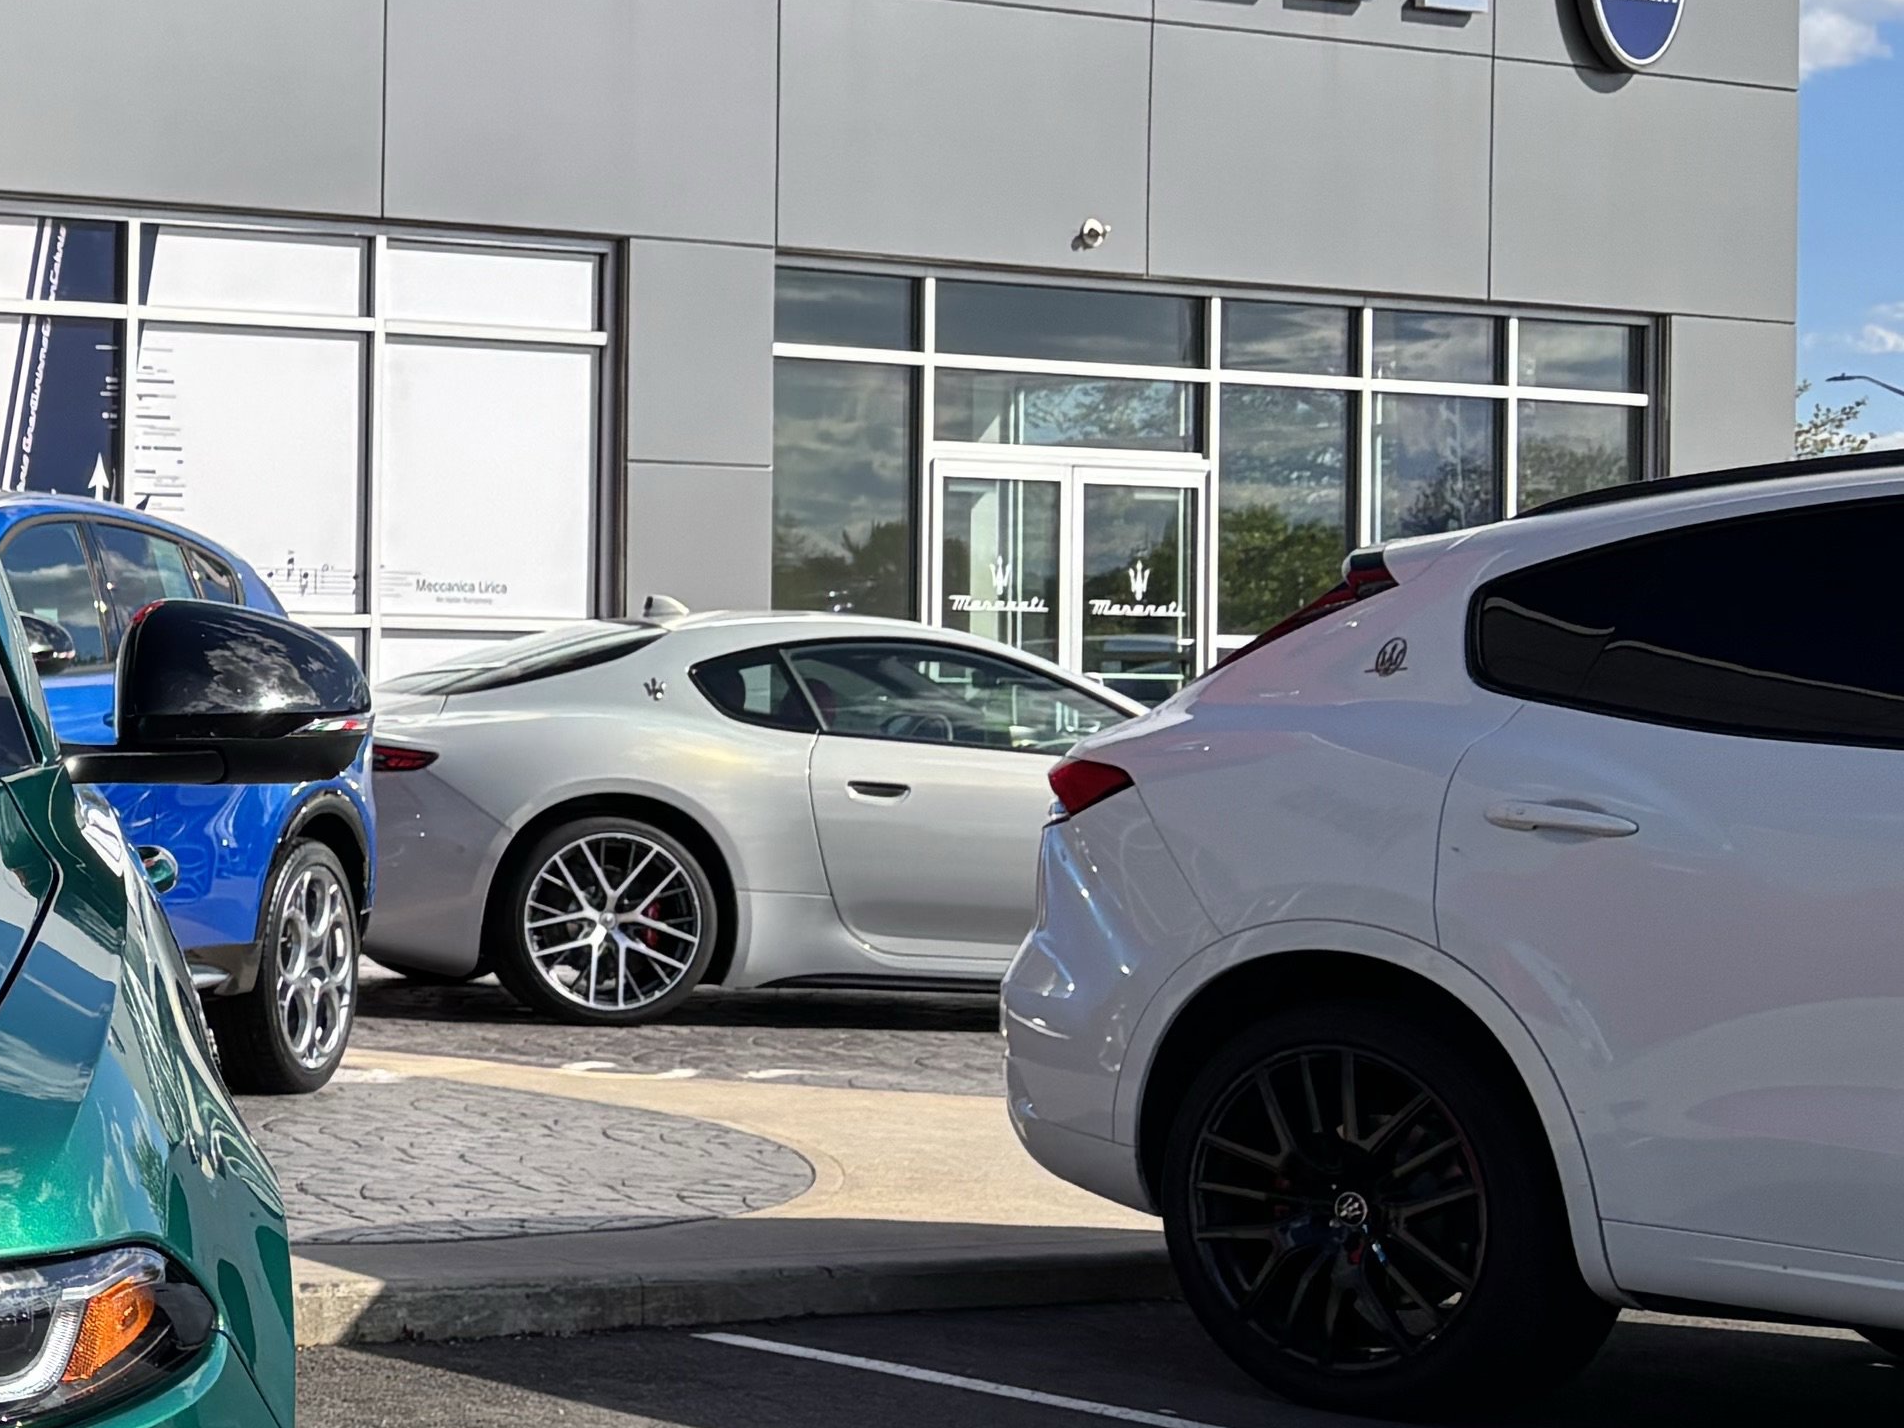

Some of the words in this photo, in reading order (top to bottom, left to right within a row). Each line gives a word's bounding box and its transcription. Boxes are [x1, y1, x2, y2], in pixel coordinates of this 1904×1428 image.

[416, 578, 475, 593] Meccanica
[479, 580, 508, 594] Lirica
[948, 594, 1049, 613] Maserati
[1089, 599, 1186, 617] Maserati
